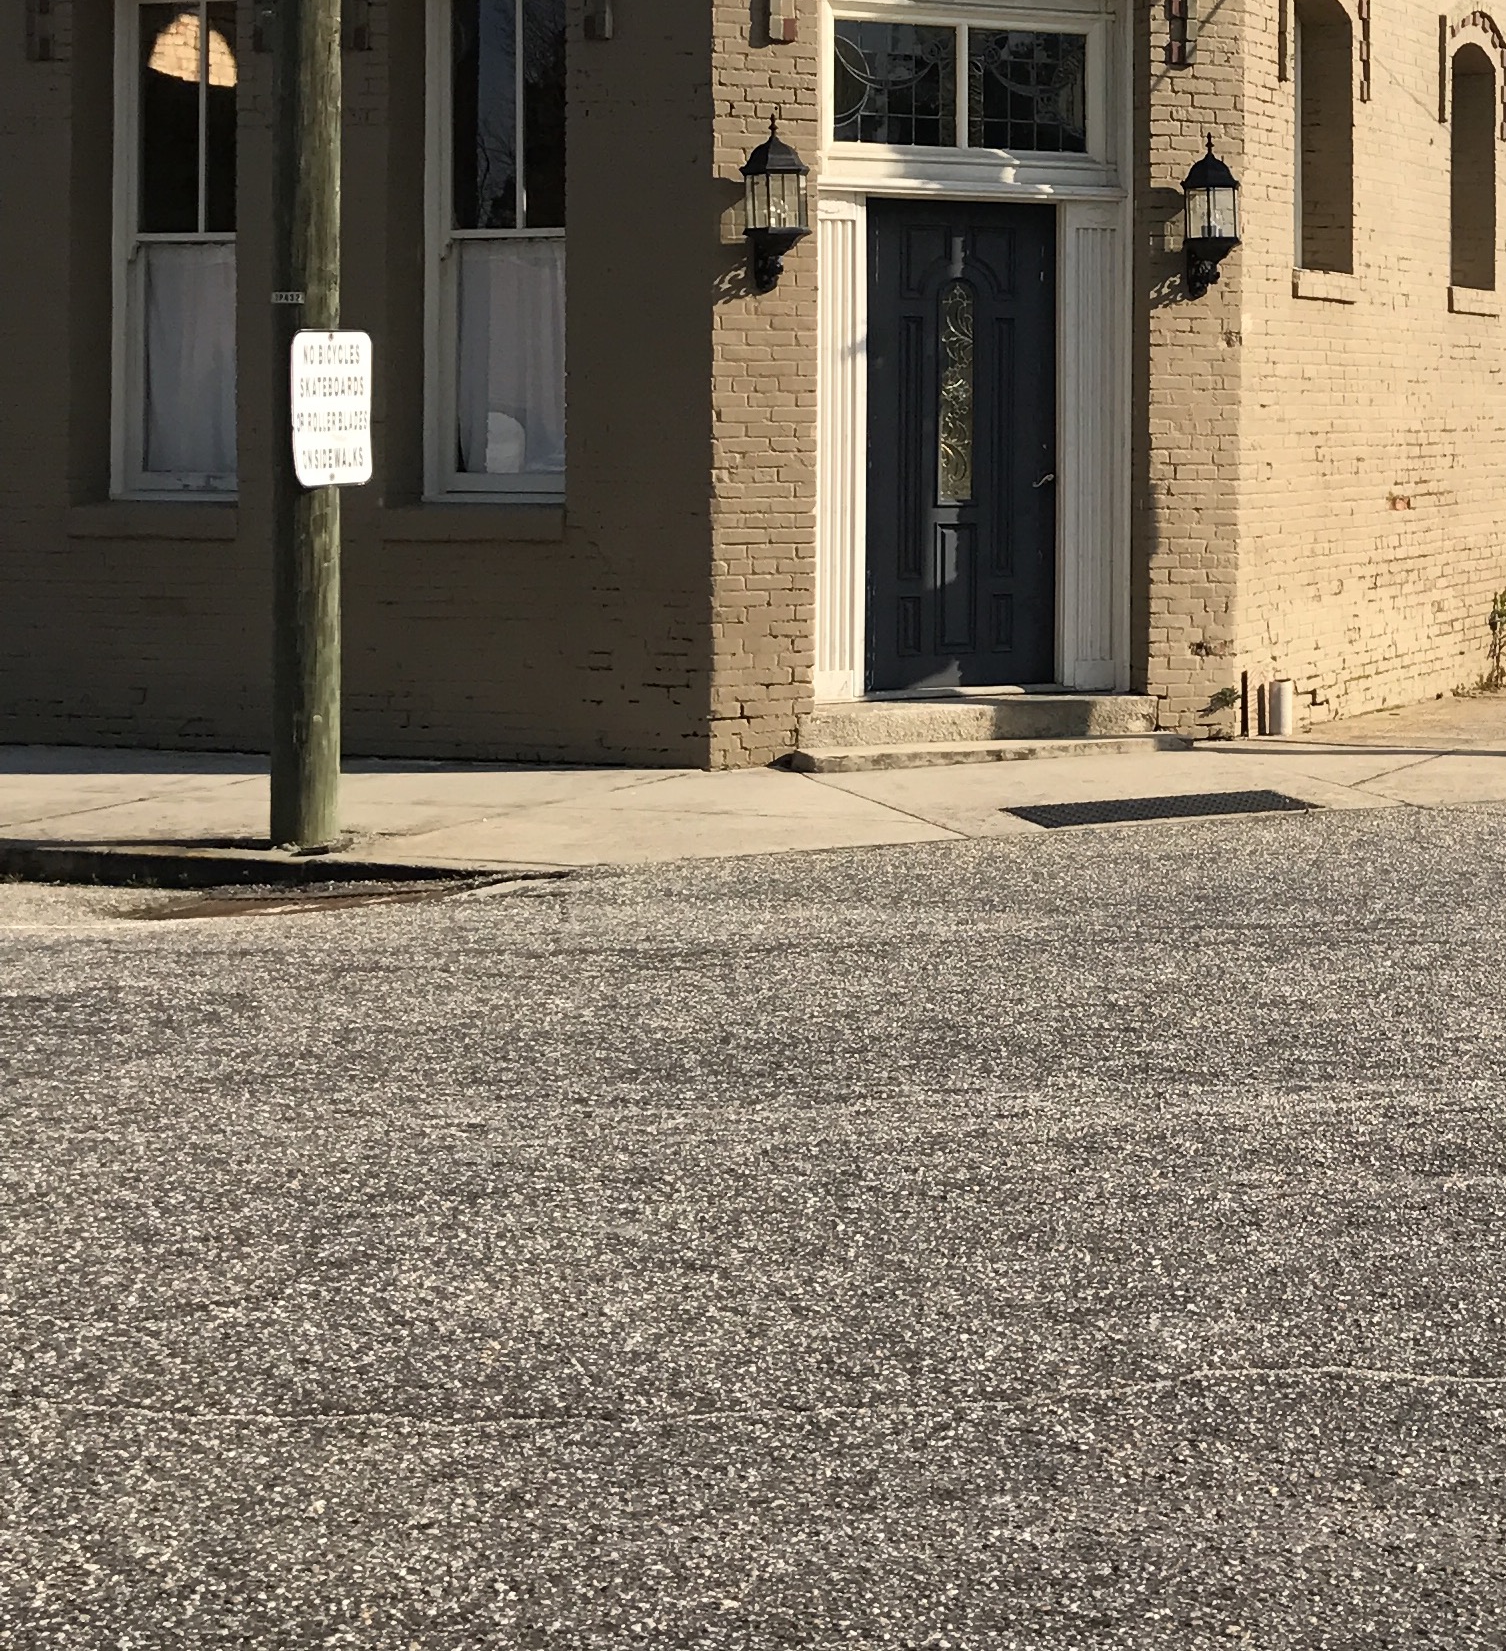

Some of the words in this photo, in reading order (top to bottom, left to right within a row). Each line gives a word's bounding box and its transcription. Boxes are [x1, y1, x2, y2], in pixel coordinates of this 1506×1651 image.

[303, 344, 314, 365] NO
[318, 343, 361, 365] BICYCLES
[299, 376, 364, 398] SKATEBOARDS
